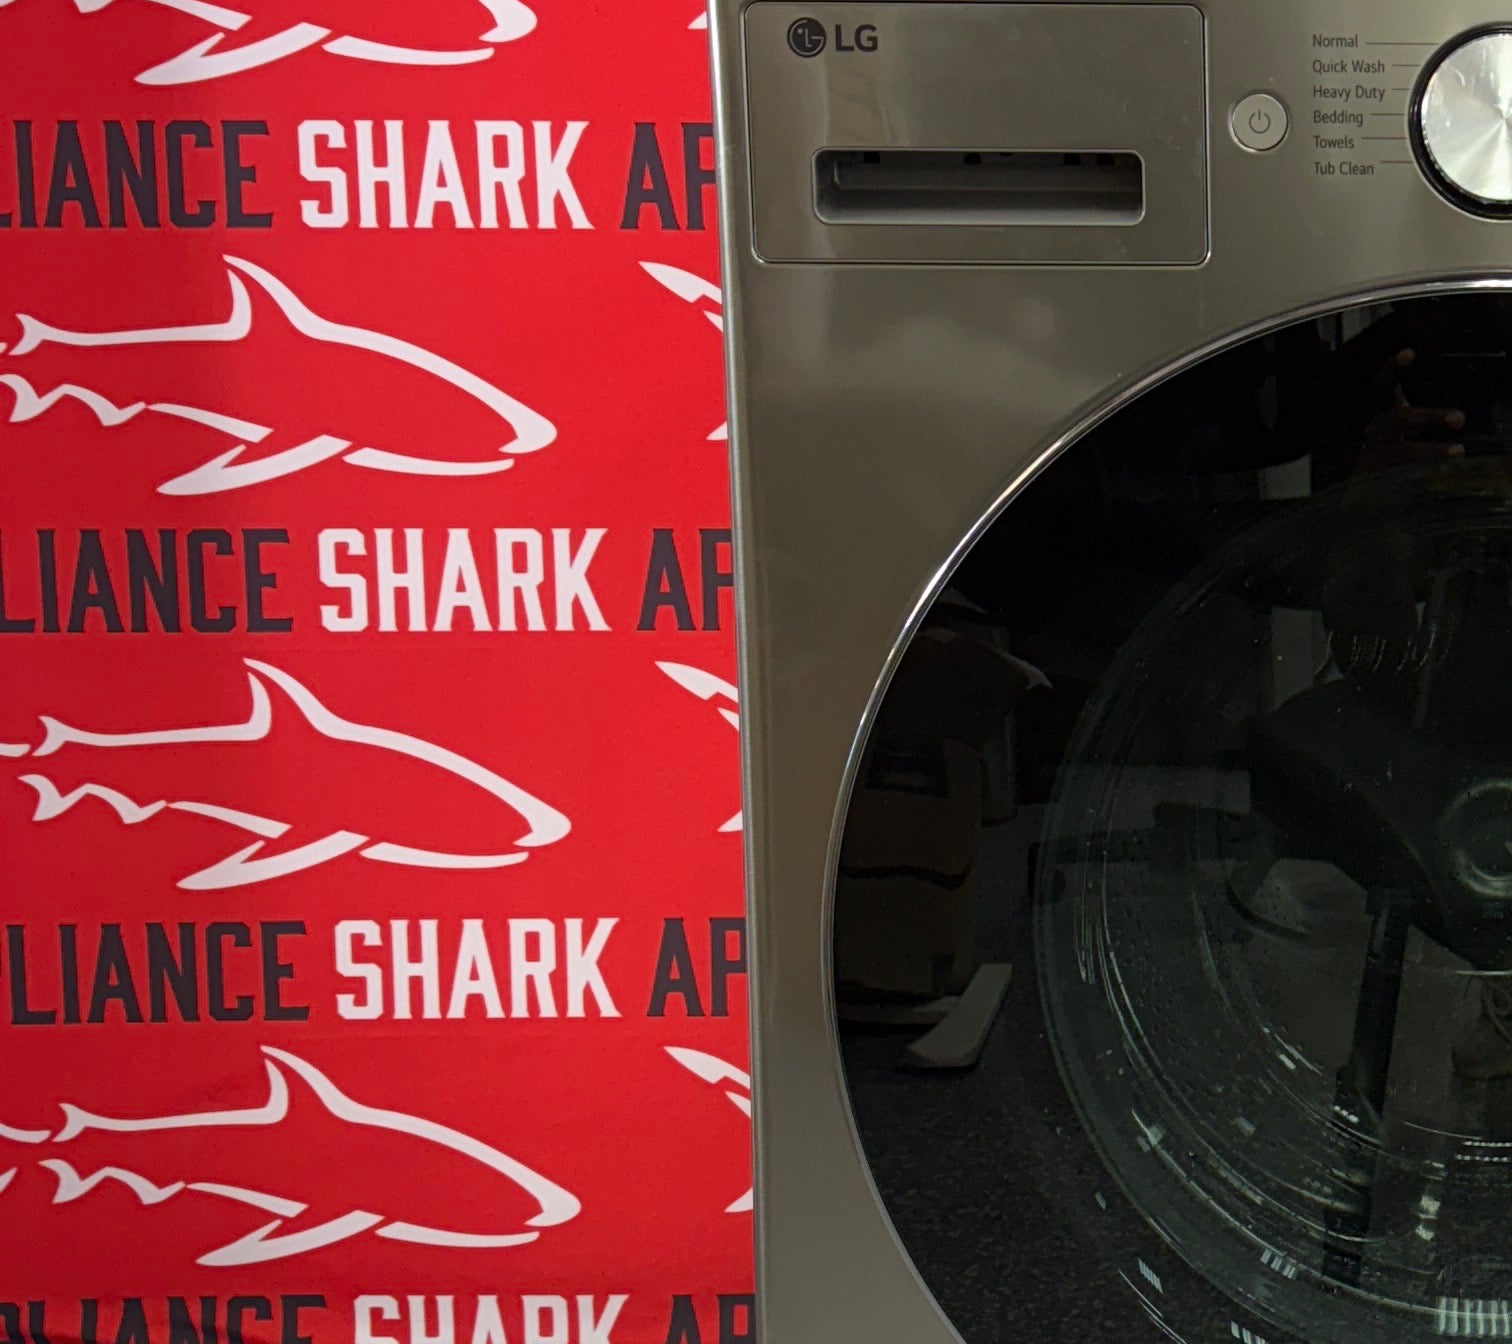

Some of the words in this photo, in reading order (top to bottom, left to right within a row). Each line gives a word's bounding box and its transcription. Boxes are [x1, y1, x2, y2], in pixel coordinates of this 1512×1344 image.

[835, 24, 878, 52] LG
[1312, 34, 1359, 48] Normal
[1312, 59, 1348, 75] Quick
[1351, 59, 1385, 73] Wash
[1313, 85, 1351, 102] Heavy
[1355, 85, 1385, 102] Duty
[1313, 110, 1364, 128] Bedding
[1313, 135, 1355, 149] Towels
[297, 119, 594, 230] SHARK
[1314, 162, 1335, 175] Tub
[1339, 162, 1375, 176] Clean
[317, 527, 612, 632] SHARK
[334, 917, 622, 1020] SHARK
